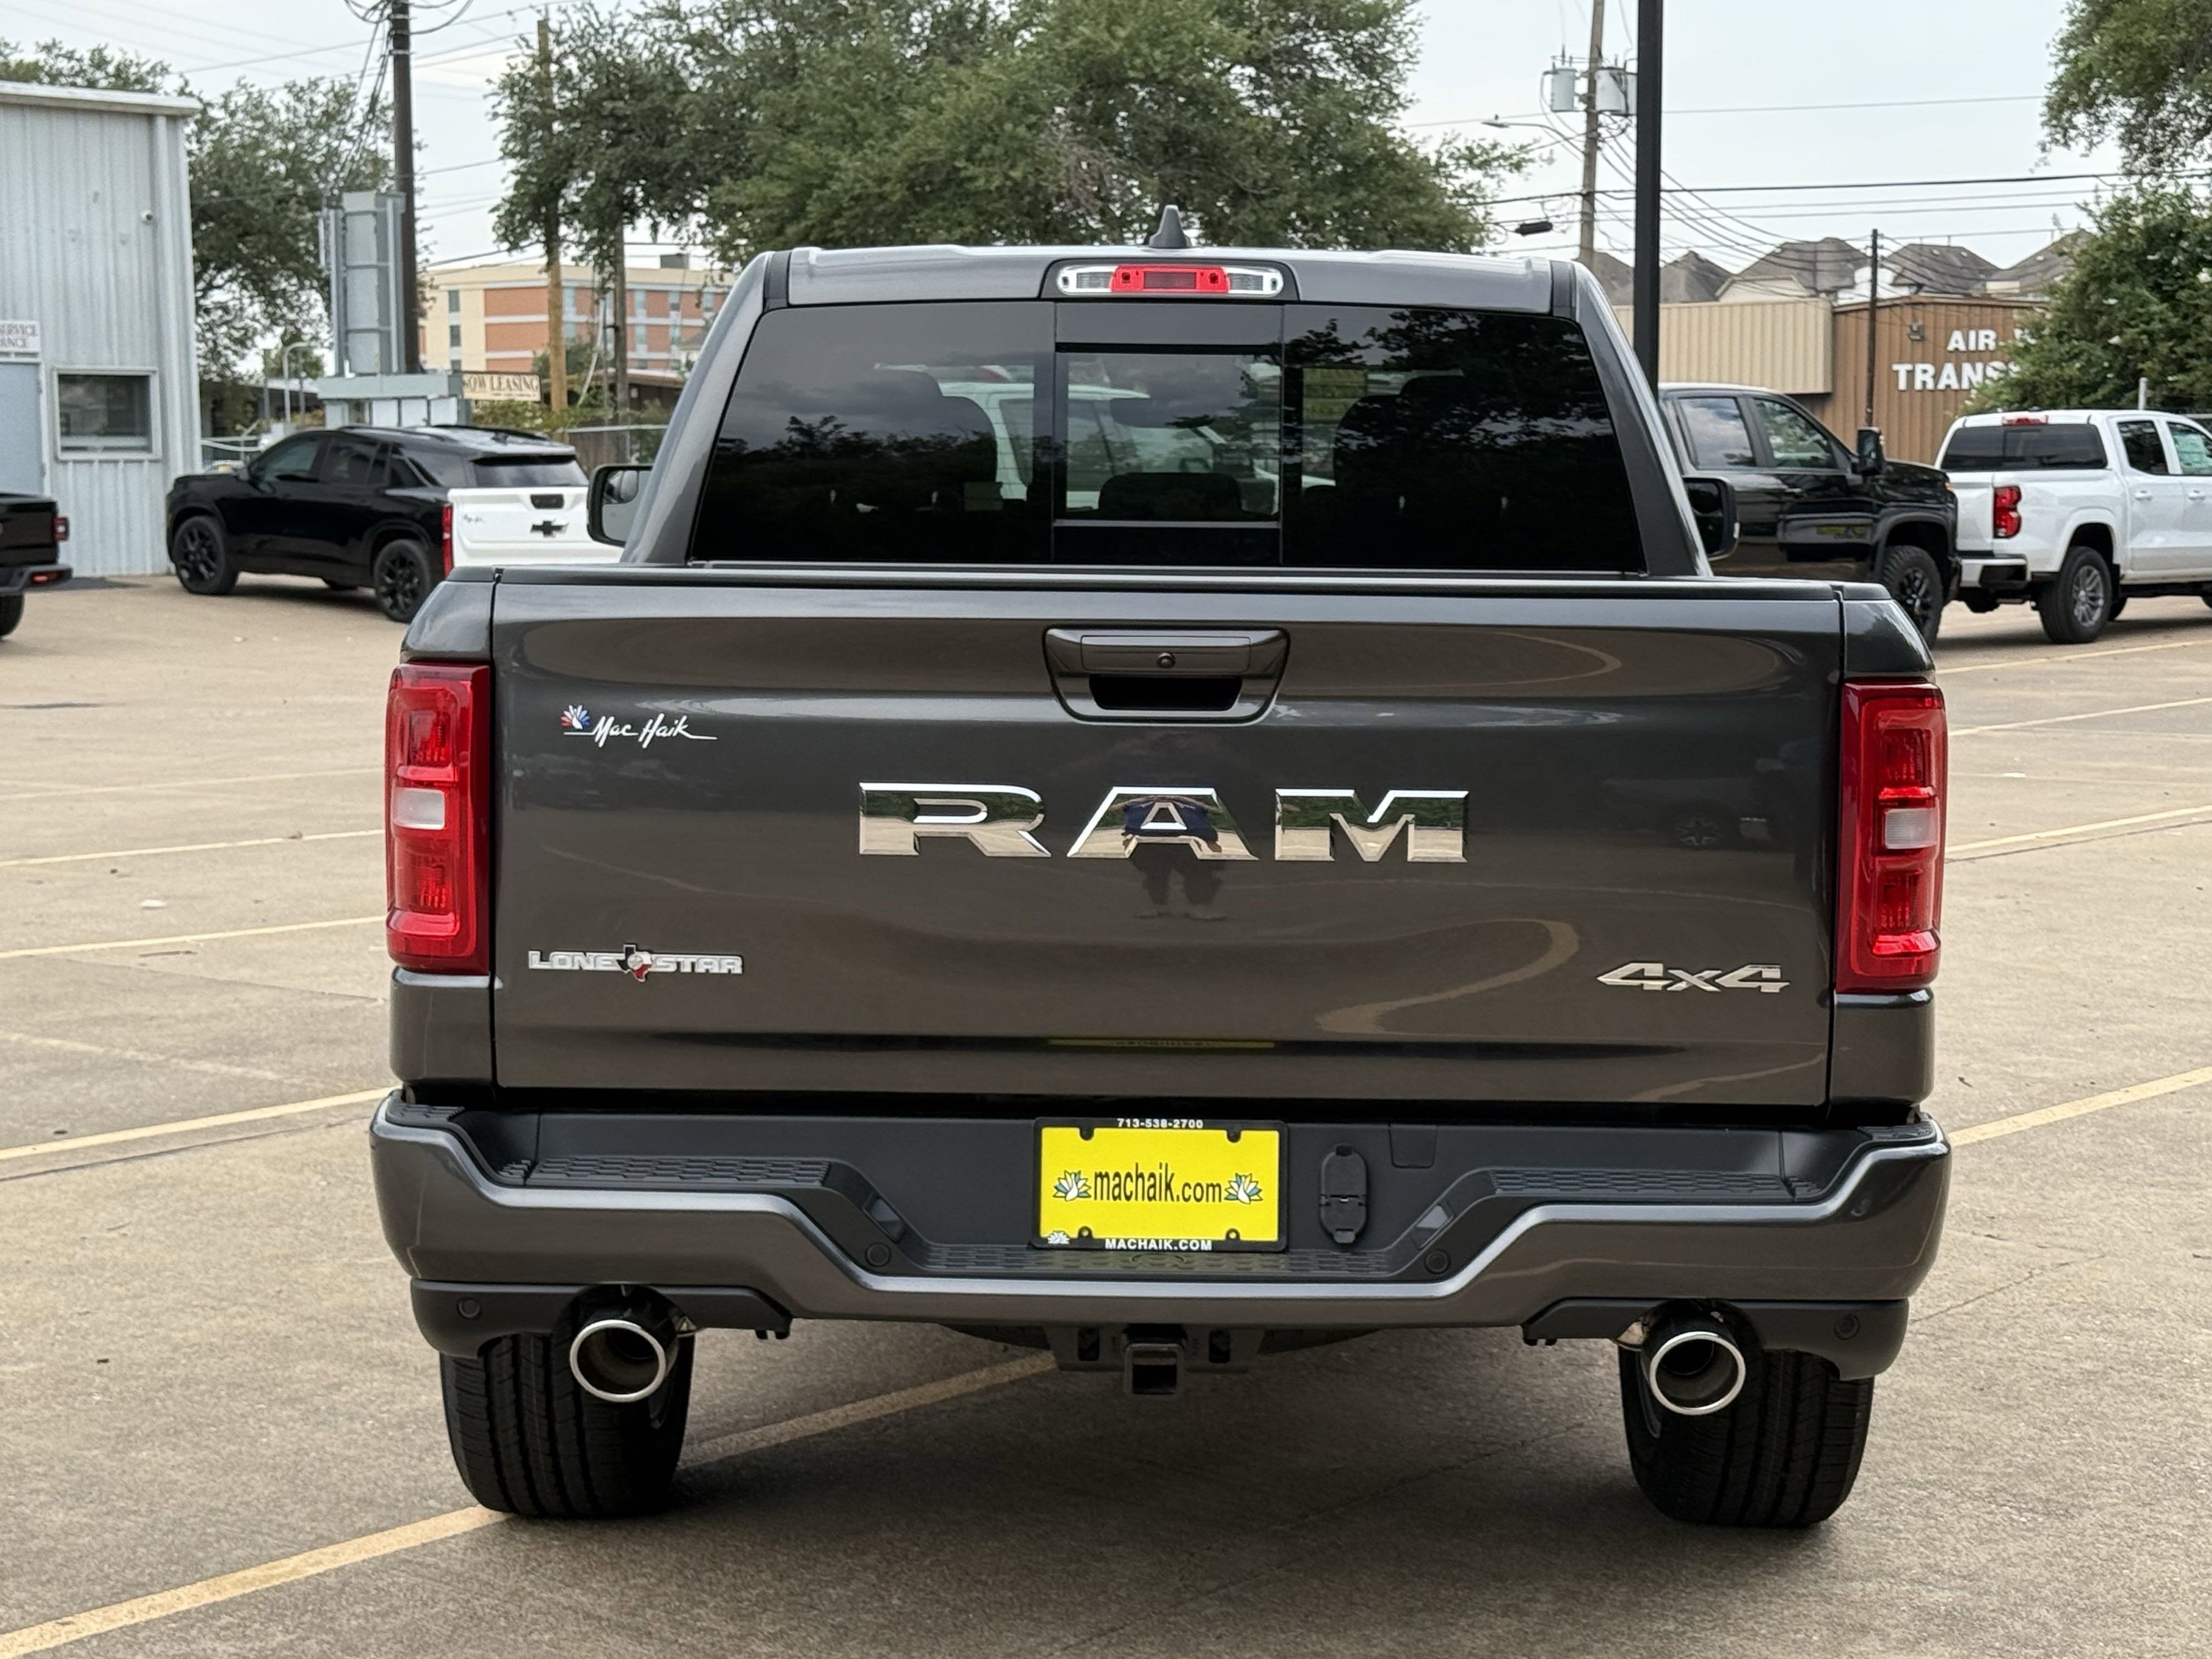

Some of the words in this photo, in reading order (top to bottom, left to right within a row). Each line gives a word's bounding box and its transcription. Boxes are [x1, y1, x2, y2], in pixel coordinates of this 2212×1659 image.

[1946, 329, 1997, 351] AIR
[490, 375, 539, 392] LEASING
[591, 715, 639, 748] Mac
[637, 712, 717, 749] Haik
[859, 782, 1470, 862] RAM
[528, 950, 613, 971] LONE
[654, 953, 743, 974] STAR
[1596, 962, 1791, 993] 4x4
[1117, 1118, 1204, 1130] 713-538-2700
[1093, 1161, 1222, 1203] machaik.com
[1104, 1238, 1212, 1251] MACHAIK.COM
